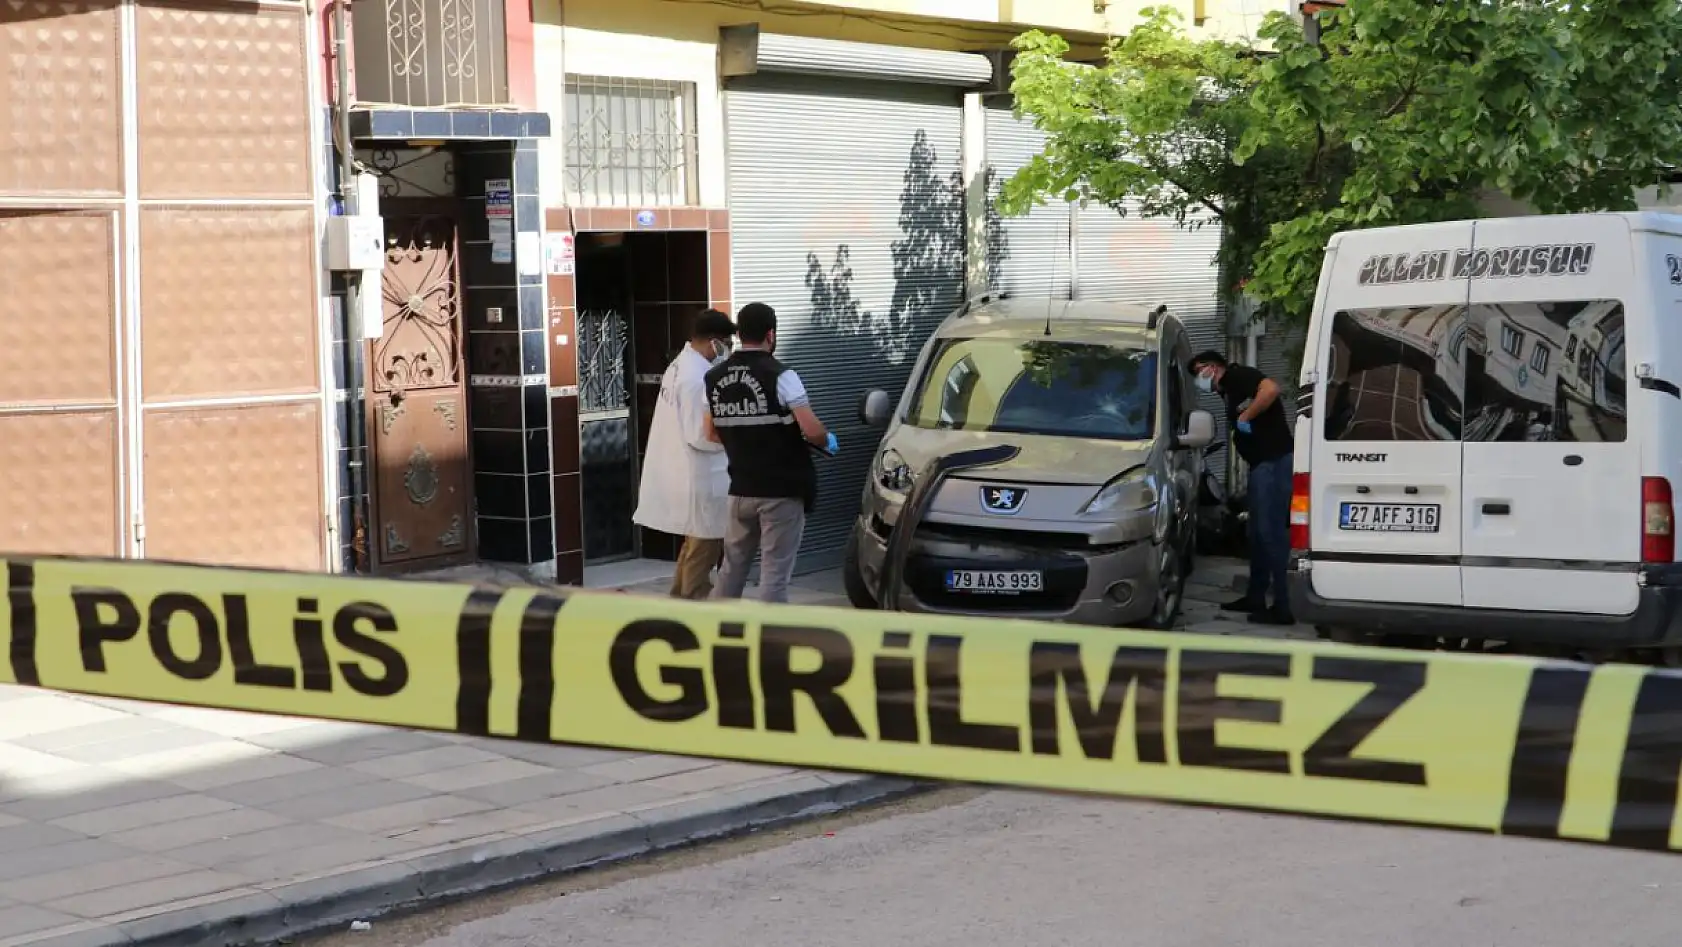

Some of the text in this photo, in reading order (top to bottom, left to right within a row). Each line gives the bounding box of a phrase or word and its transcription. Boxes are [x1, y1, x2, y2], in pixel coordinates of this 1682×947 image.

[1452, 242, 1595, 280] KORUSUN
[719, 398, 758, 417] POLİS
[1335, 453, 1388, 462] TRANSIT
[1350, 506, 1435, 525] 27 AFF 316
[953, 572, 1040, 589] 79 AAS 993
[71, 585, 1429, 786] POLİS GİRİLMEZ
